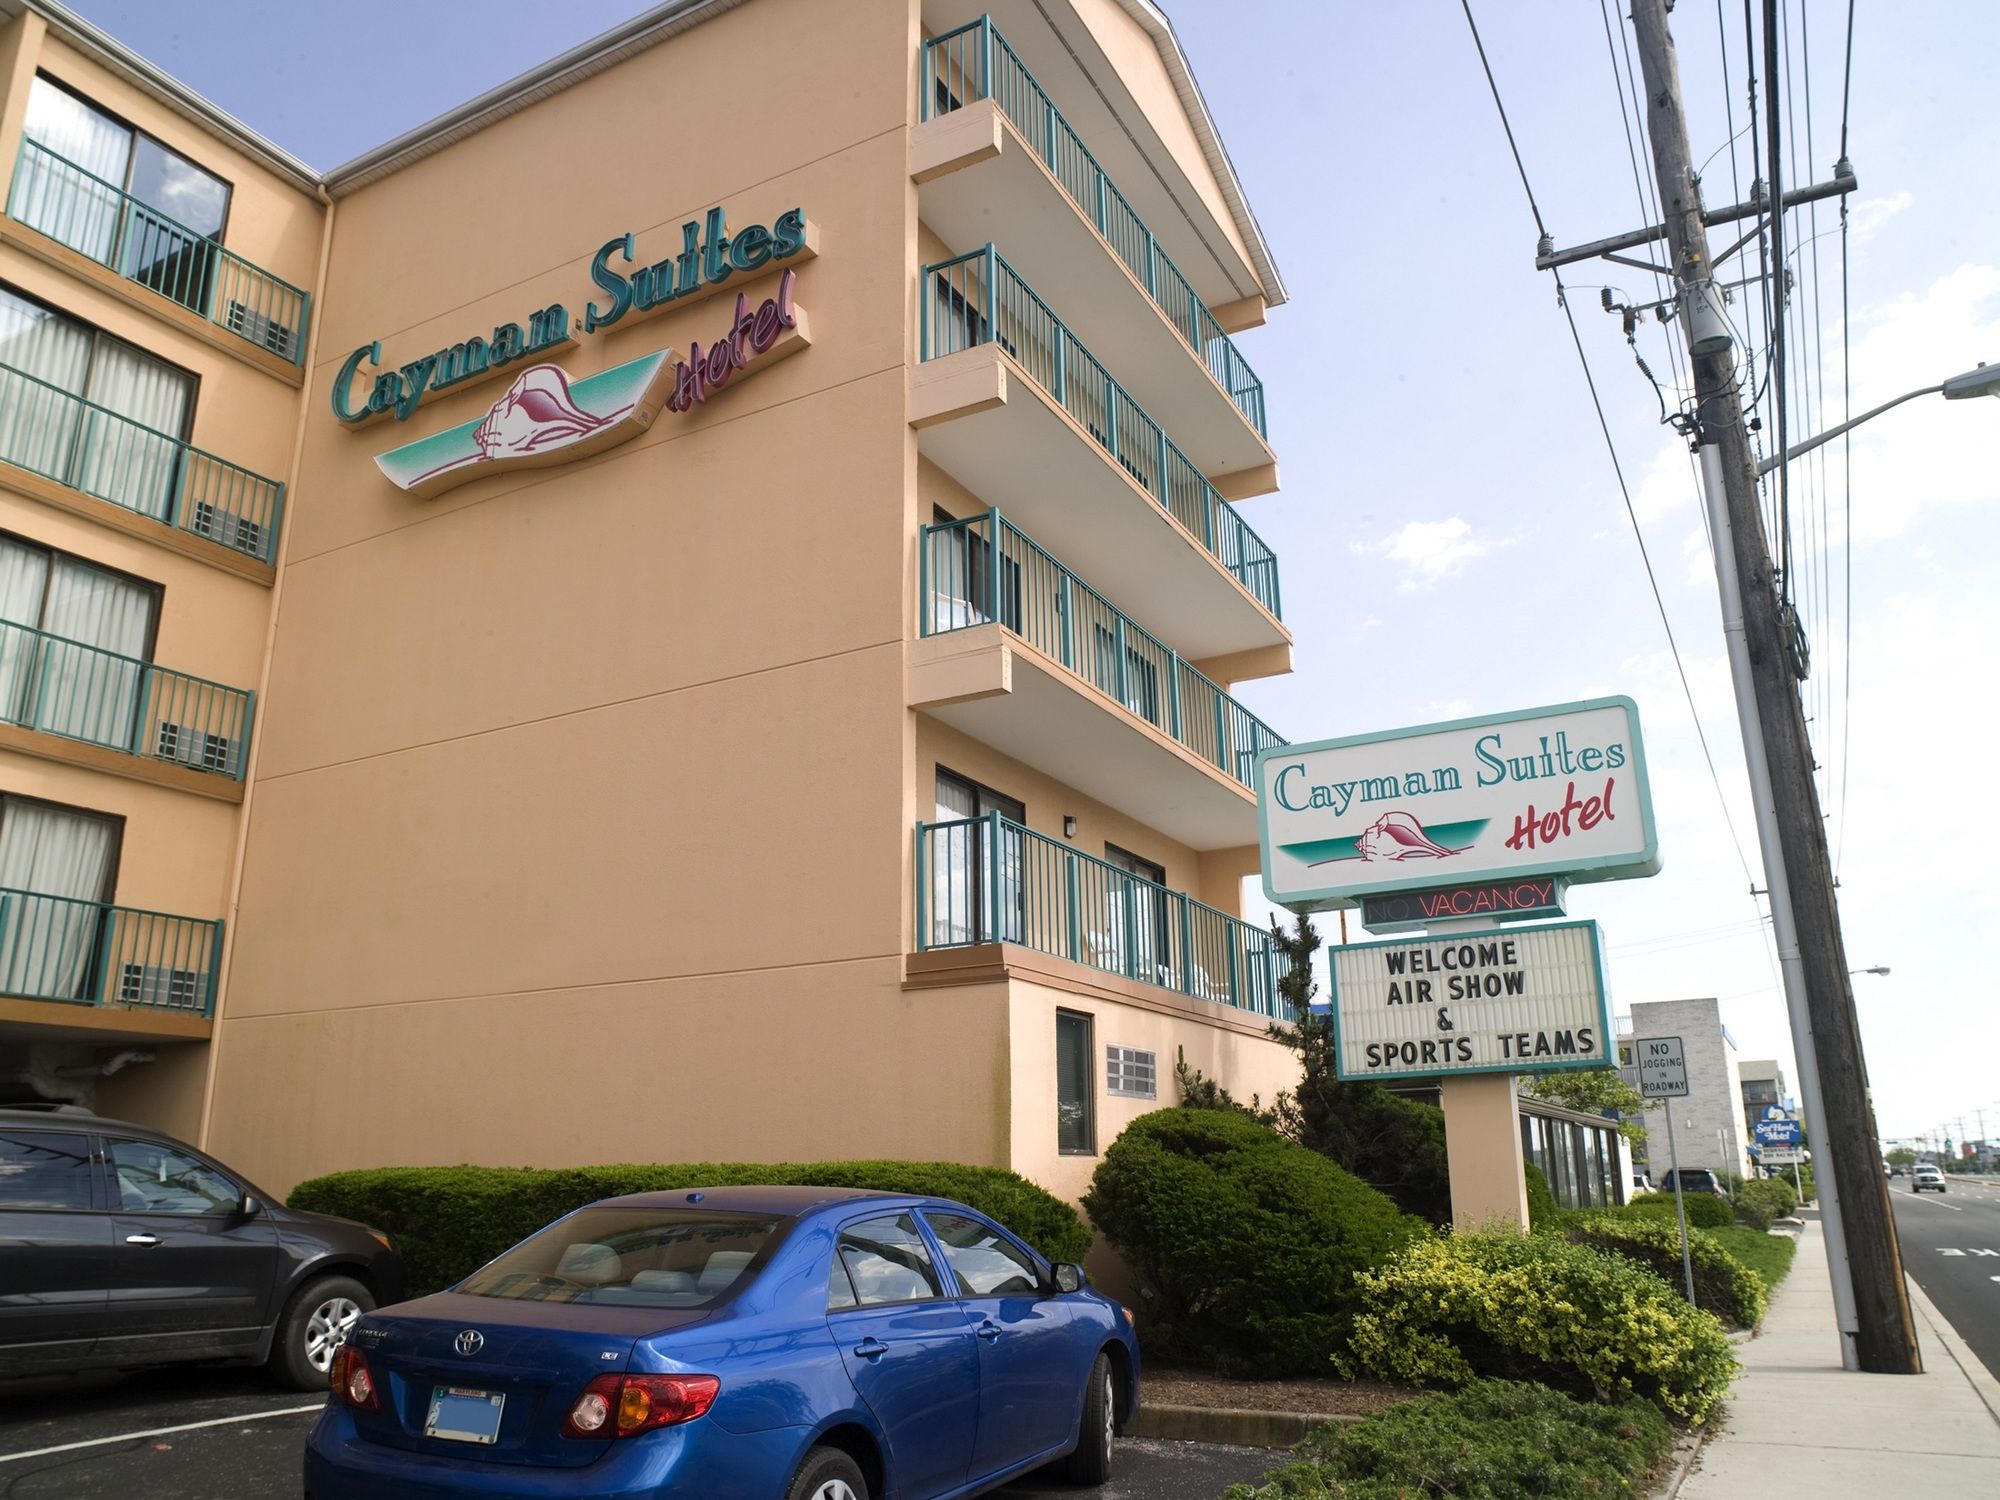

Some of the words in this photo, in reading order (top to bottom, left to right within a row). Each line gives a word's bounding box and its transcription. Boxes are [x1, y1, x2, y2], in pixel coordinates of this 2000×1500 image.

[331, 303, 569, 422] Cayman
[585, 206, 806, 334] Suites
[665, 267, 797, 414] Hotel
[1273, 763, 1462, 817] Cayman
[1475, 731, 1626, 788] Suites
[1504, 777, 1616, 851] Hotel
[1367, 900, 1410, 922] NO
[1417, 882, 1552, 918] VACANCY
[1385, 940, 1518, 976] WELCOME
[1386, 979, 1433, 1006] AIR
[1447, 970, 1525, 1000] SHOW
[1436, 1007, 1454, 1031] &
[1366, 1036, 1473, 1068] SPORTS
[1497, 1028, 1595, 1059] TEAMS
[1642, 1057, 1682, 1069] JOGGING
[1650, 1043, 1669, 1055] NO
[1643, 1081, 1685, 1092] ROADWAY
